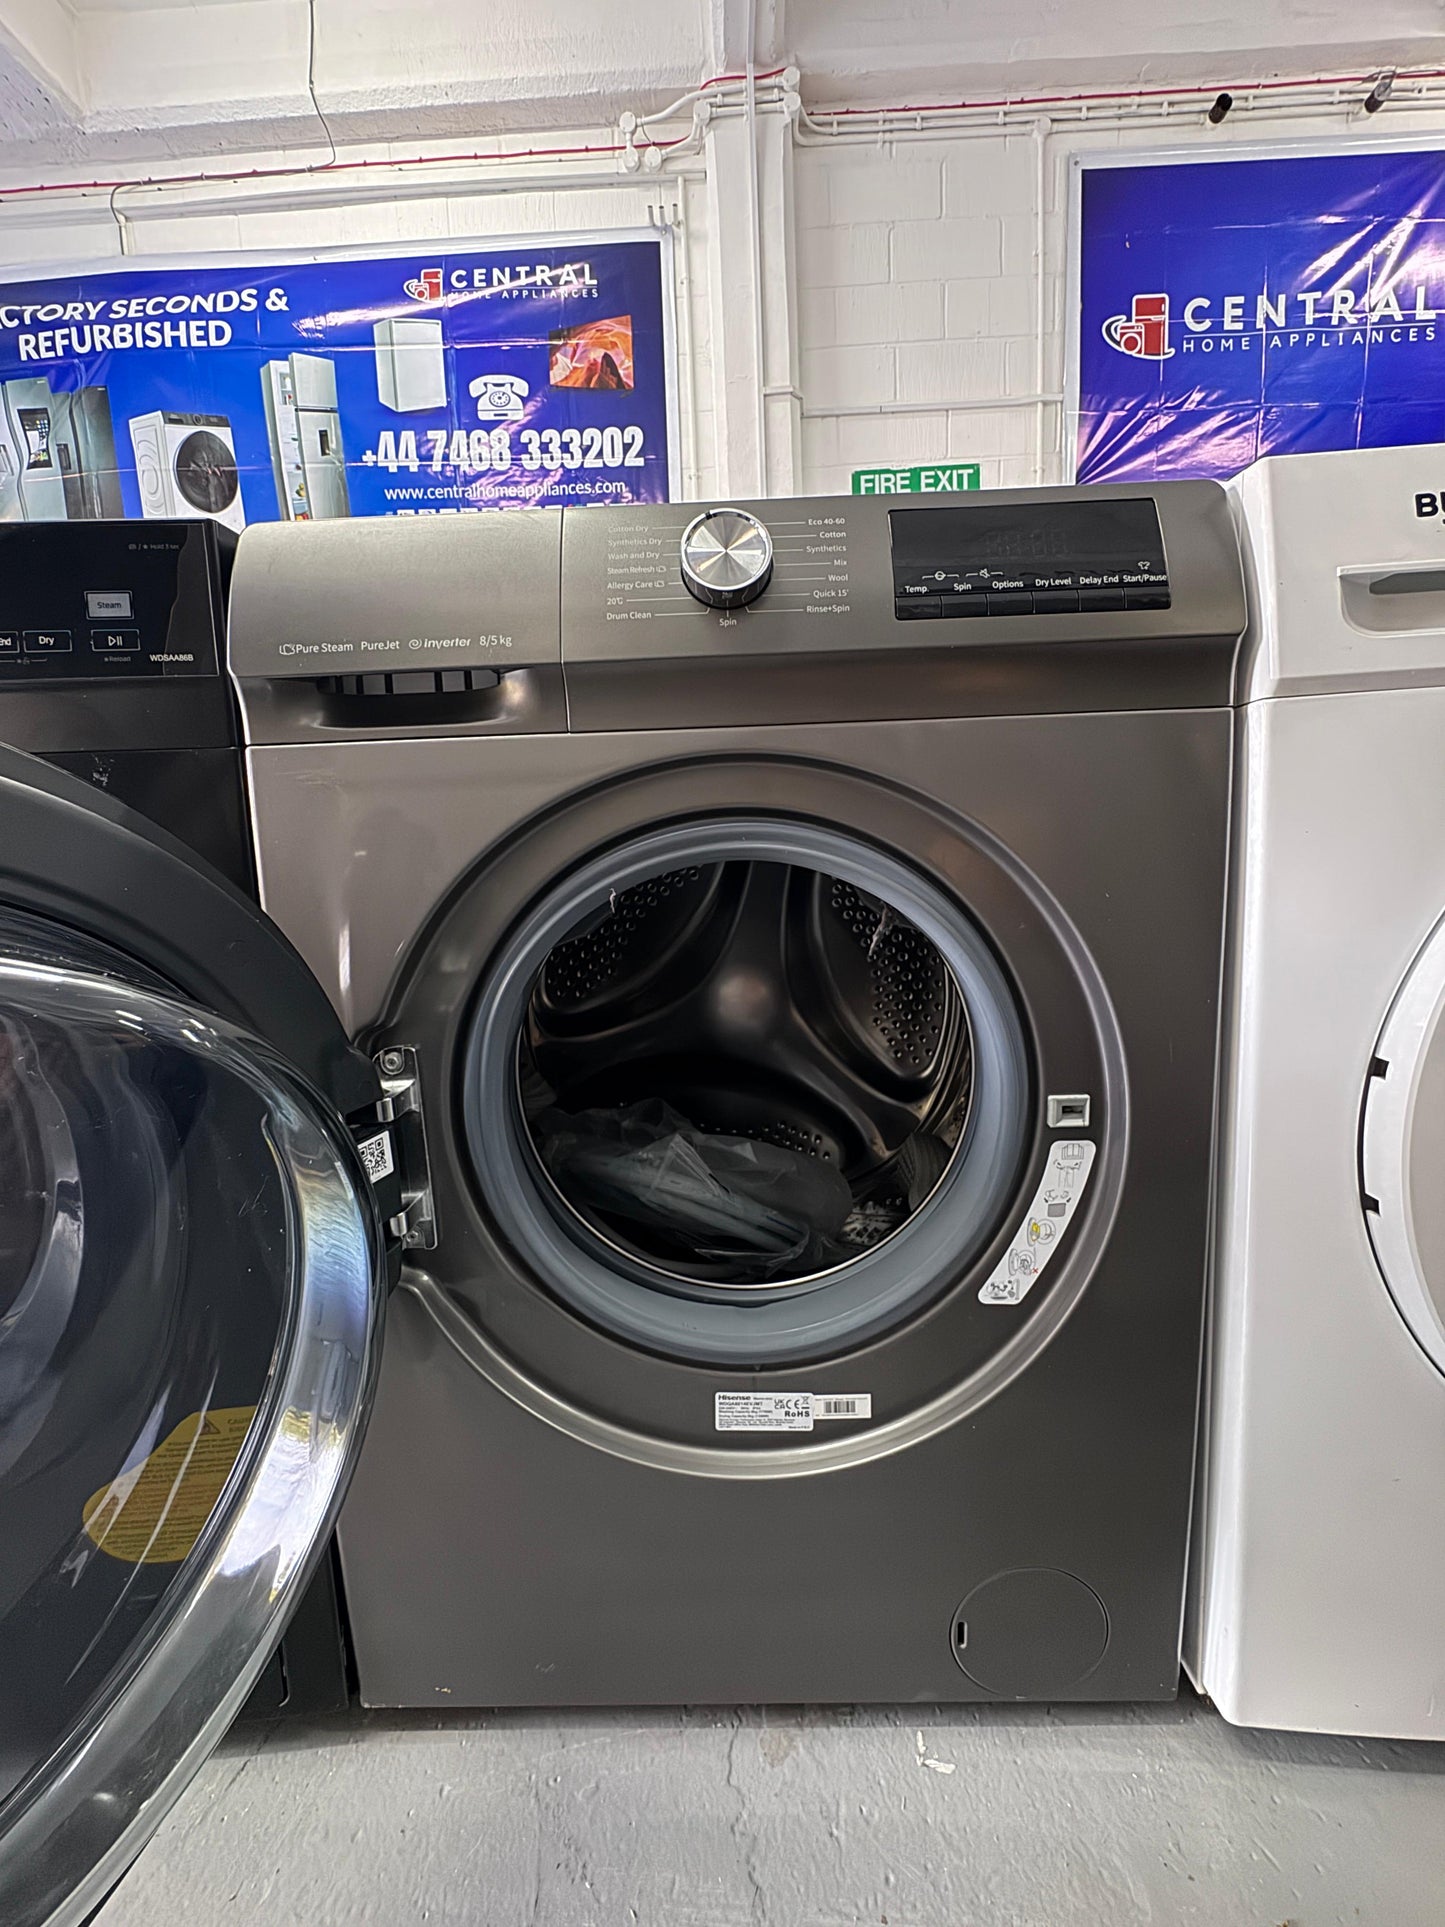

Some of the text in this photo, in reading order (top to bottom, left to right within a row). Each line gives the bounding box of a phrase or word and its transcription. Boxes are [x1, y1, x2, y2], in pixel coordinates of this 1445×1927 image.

[449, 263, 599, 289] CENTRAL
[501, 287, 599, 299] APPLIANCES
[109, 288, 258, 319] SECONDS
[265, 288, 290, 311] &
[1183, 285, 1437, 332] CENTRAL
[19, 320, 232, 361] REFURBISHED
[1183, 326, 1437, 353] HOME APPLIANCES
[362, 425, 646, 473] +44 7468 333202
[860, 469, 974, 495] FIRE EXIT
[384, 481, 626, 501] www.centralhomeappliances.com
[608, 539, 648, 547] Synthetics
[646, 551, 660, 559] Dry
[806, 545, 847, 554] Synthetics
[607, 567, 629, 575] Steam
[607, 582, 633, 590] Allergy
[904, 573, 1167, 594] Temp. Spin Options Dry Level Delay End Start/Pause
[813, 590, 836, 598] Quick
[96, 601, 122, 609] Steam
[806, 604, 850, 613] Rinse+Spin
[606, 611, 652, 620] Drum Clean
[719, 618, 737, 627] Spin
[38, 636, 55, 646] Dry
[296, 644, 319, 654] Pure
[321, 643, 353, 653] Steam
[360, 640, 400, 650] PureJet
[479, 635, 498, 647] 8/5
[500, 635, 512, 648] kg
